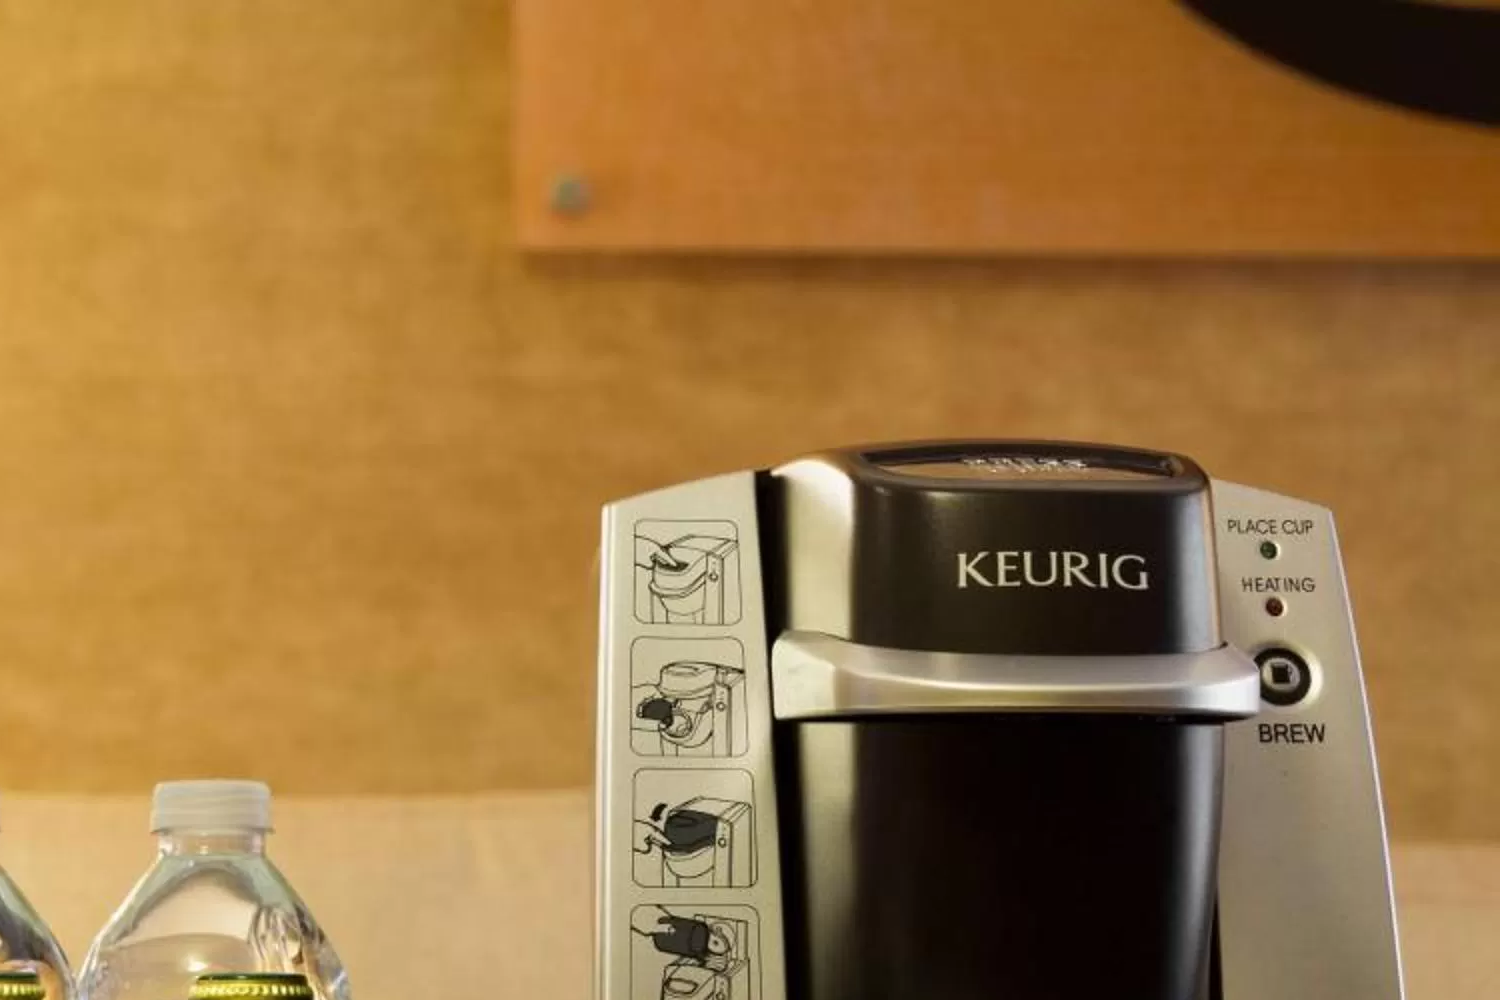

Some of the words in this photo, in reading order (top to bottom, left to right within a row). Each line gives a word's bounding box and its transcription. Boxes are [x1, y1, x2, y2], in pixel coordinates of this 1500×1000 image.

[1227, 519, 1277, 535] PLACE
[1281, 519, 1314, 535] CUP
[956, 550, 1150, 590] KEURIG
[1241, 577, 1316, 593] HEATING
[1258, 723, 1326, 744] BREW
